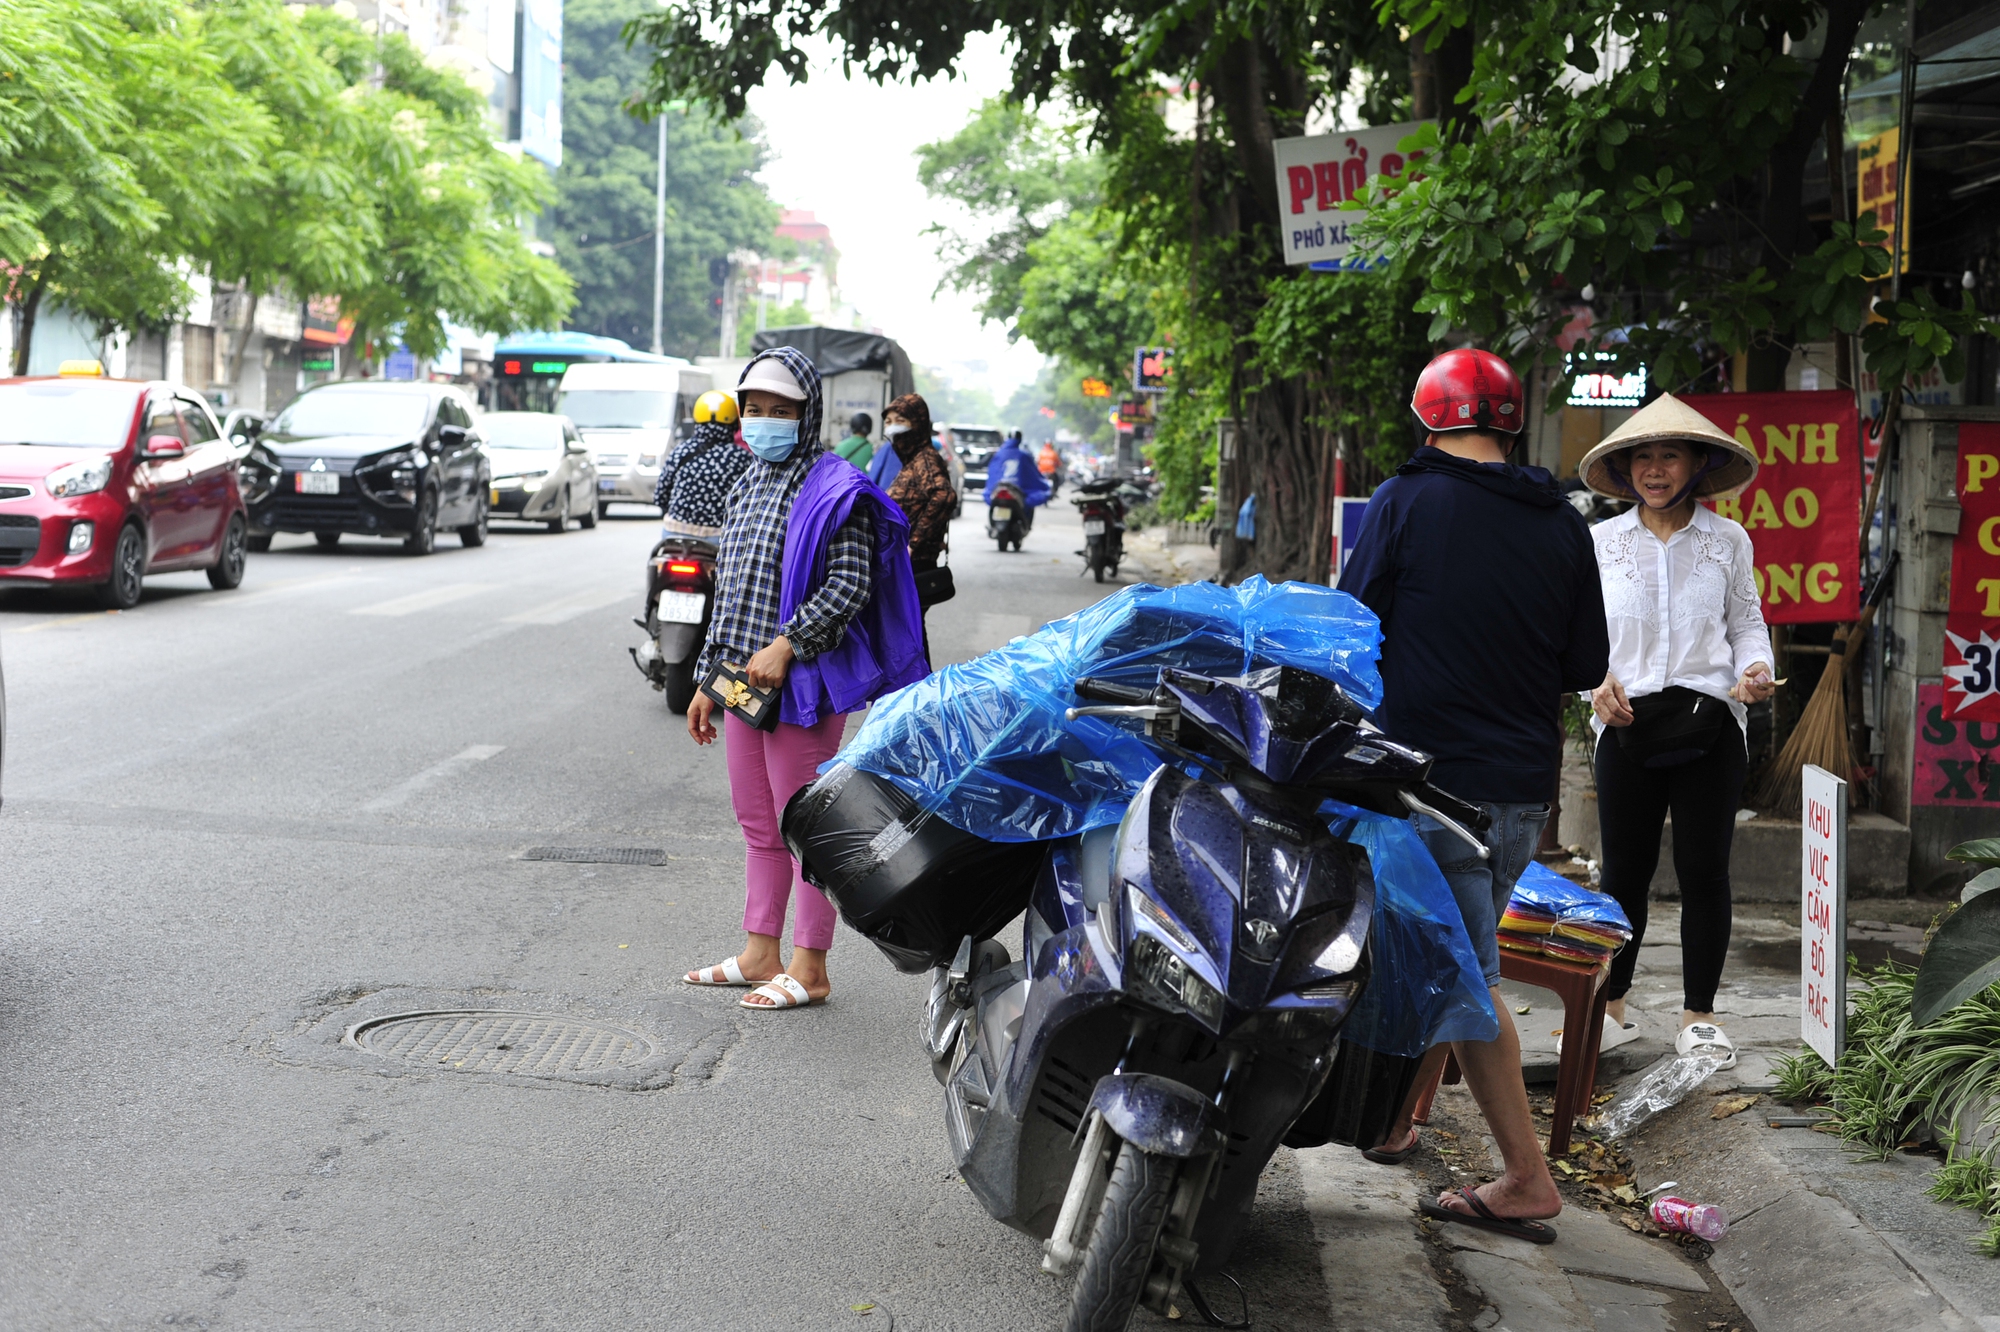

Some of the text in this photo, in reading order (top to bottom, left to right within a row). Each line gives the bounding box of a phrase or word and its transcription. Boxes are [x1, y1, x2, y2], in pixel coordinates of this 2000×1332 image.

[1287, 138, 1368, 214] PHỞ
[1293, 220, 1358, 250] PHỞ XÀ
[1965, 454, 2000, 492] P
[1715, 486, 1819, 529] BAO
[1963, 644, 2000, 693] 3
[1808, 797, 1831, 839] KHU
[1807, 888, 1830, 935] CẤM
[1808, 982, 1828, 1028] RÁC
